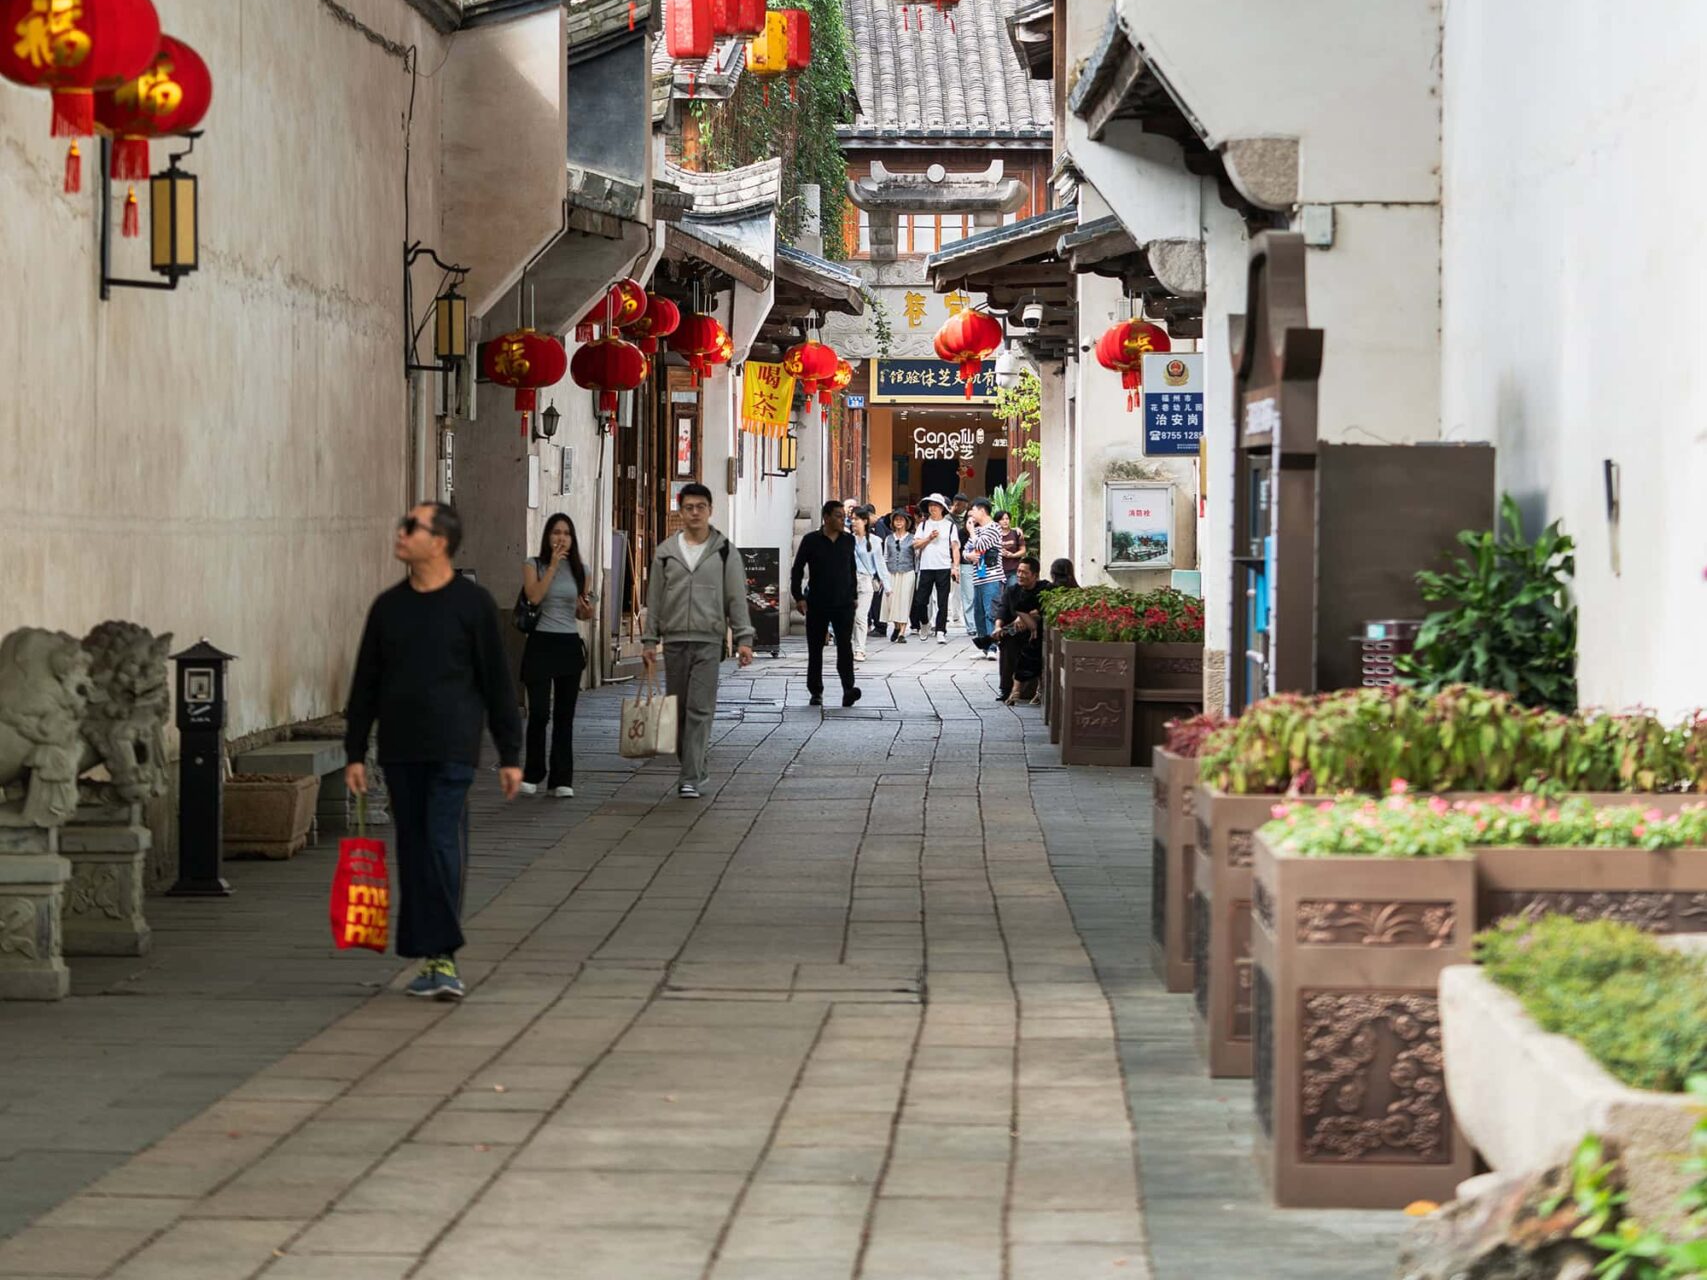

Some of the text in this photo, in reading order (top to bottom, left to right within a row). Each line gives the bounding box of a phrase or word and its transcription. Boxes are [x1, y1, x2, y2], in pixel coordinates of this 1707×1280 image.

[752, 365, 780, 419] 喝茶
[1161, 394, 1193, 403] 福州市
[1150, 403, 1203, 412] 花巷幼儿园
[1155, 413, 1199, 426] 治安岗
[1161, 431, 1182, 440] 8755
[914, 442, 955, 460] herb
